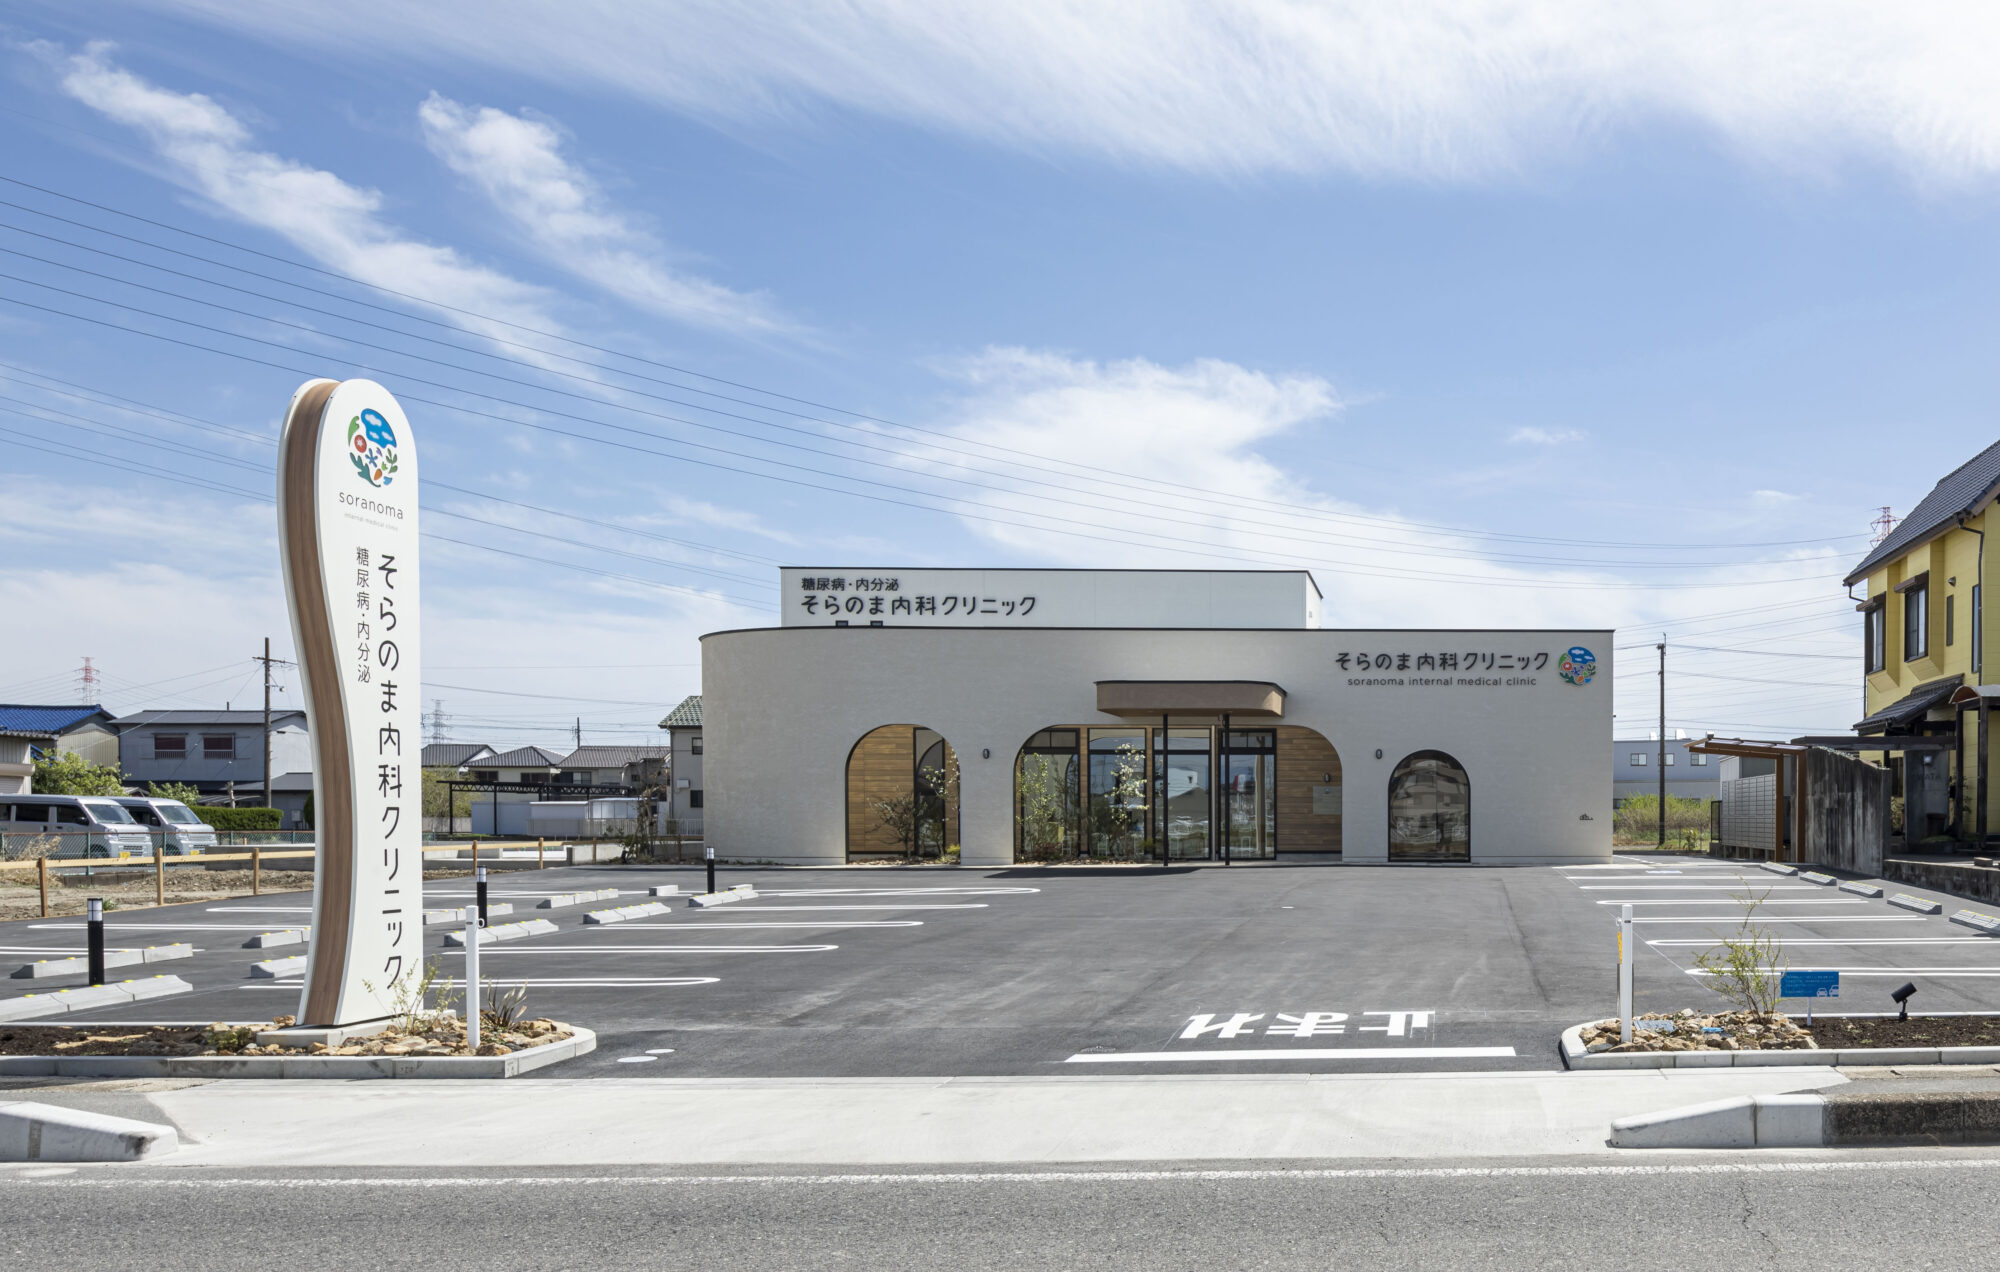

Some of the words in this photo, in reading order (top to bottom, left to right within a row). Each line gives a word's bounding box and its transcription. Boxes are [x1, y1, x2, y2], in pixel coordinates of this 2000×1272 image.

[339, 492, 404, 520] soranoma
[801, 577, 900, 592] 糖尿病・内分泌
[356, 546, 370, 683] 糖尿病・内分泌
[800, 595, 1036, 616] そらのま内科クリニック
[1335, 652, 1549, 672] そらのま内科クリニック
[1347, 678, 1404, 686] soranoma
[1408, 676, 1453, 686] internal
[1457, 676, 1502, 686] medical
[1506, 676, 1537, 686] clinic
[378, 554, 403, 990] そらのま内科クリニック
[1179, 1010, 1435, 1039] 止まれ
